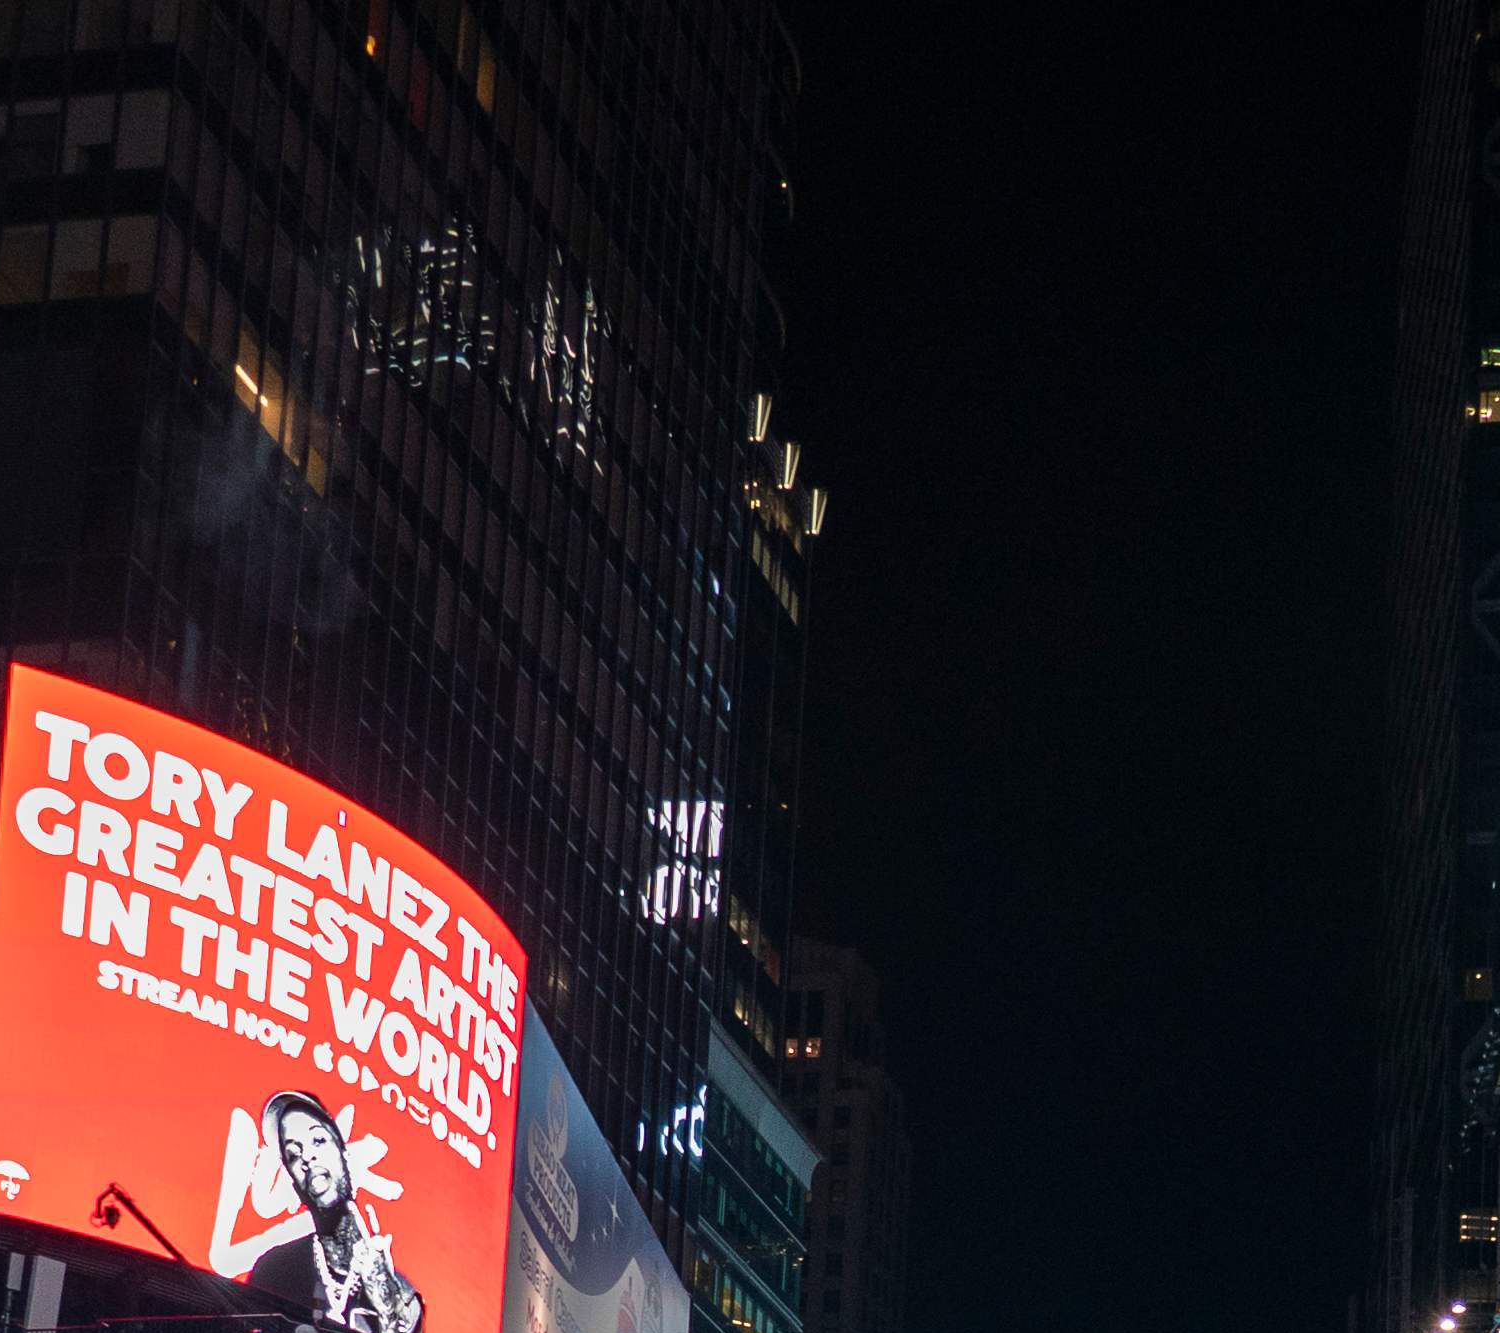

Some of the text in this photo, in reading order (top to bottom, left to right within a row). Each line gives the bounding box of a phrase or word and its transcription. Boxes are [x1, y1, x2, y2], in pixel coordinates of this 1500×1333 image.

[16, 787, 517, 1096] GREATEST ARTIST
[34, 711, 519, 1031] TORY LANEZ THE
[62, 872, 496, 1151] IN THE WORLD.
[98, 961, 306, 1060] STREAM NOW
